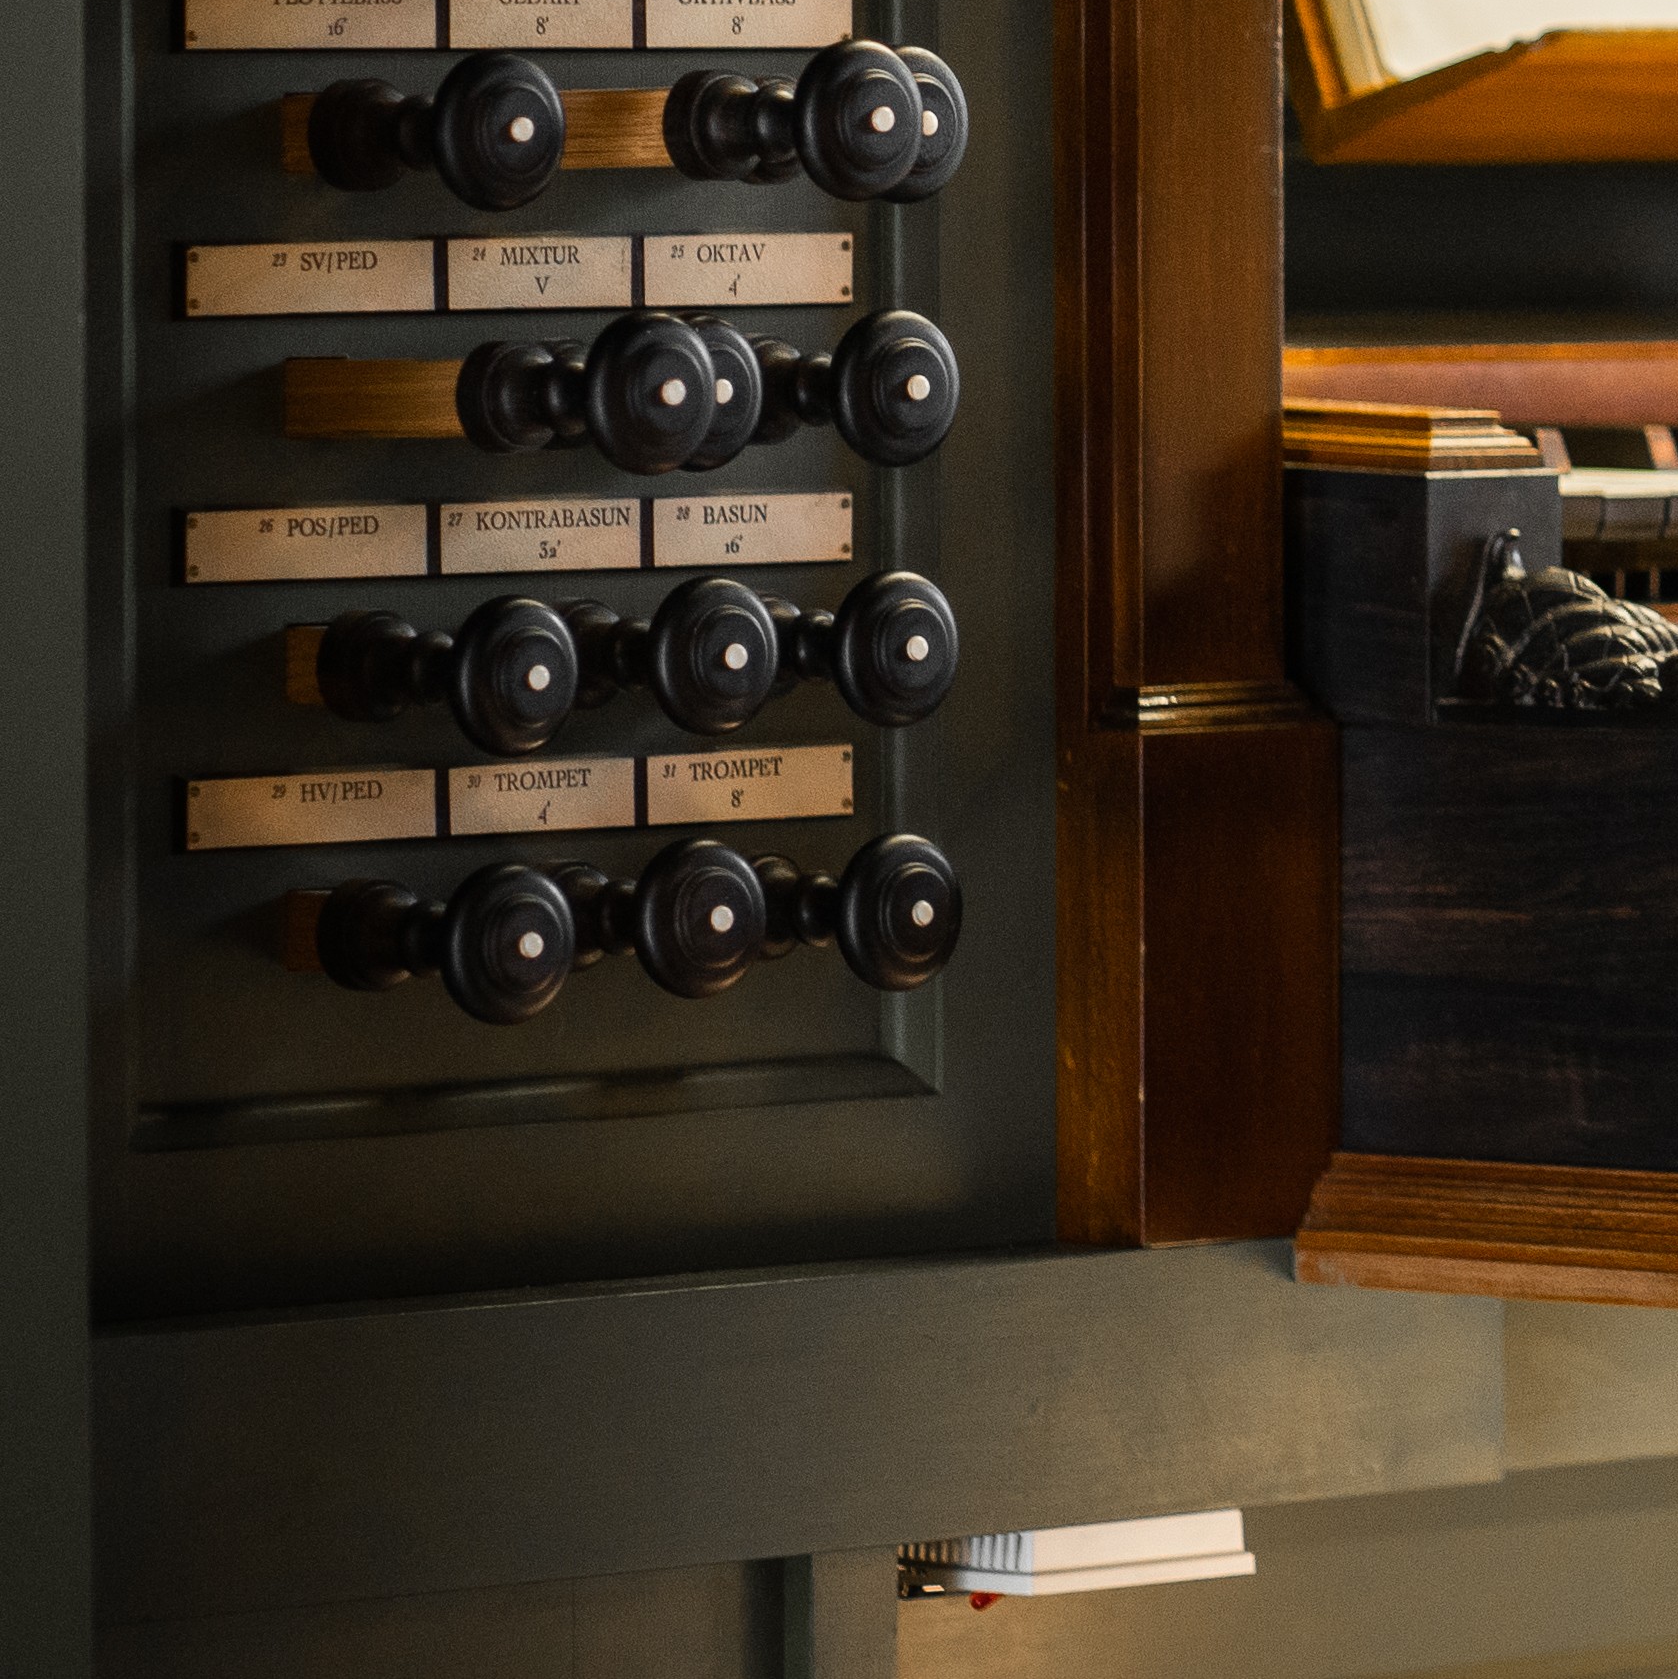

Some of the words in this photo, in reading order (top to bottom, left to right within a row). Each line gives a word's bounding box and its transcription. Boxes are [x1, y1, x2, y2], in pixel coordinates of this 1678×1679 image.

[272, 252, 287, 267] 23
[300, 250, 378, 273] SV/PED
[500, 245, 581, 266] MIXTUR
[670, 244, 684, 259] 25
[696, 243, 766, 264] OKTAV
[535, 276, 550, 295] V
[476, 507, 631, 532] KONTRABASUN
[702, 504, 768, 525] BASUN
[287, 515, 380, 538] POS/PED
[466, 774, 481, 789] 30
[493, 768, 591, 792] TROMPET
[662, 763, 677, 779] 31
[688, 756, 783, 782] TROMPET
[300, 779, 383, 804] HV/PED
